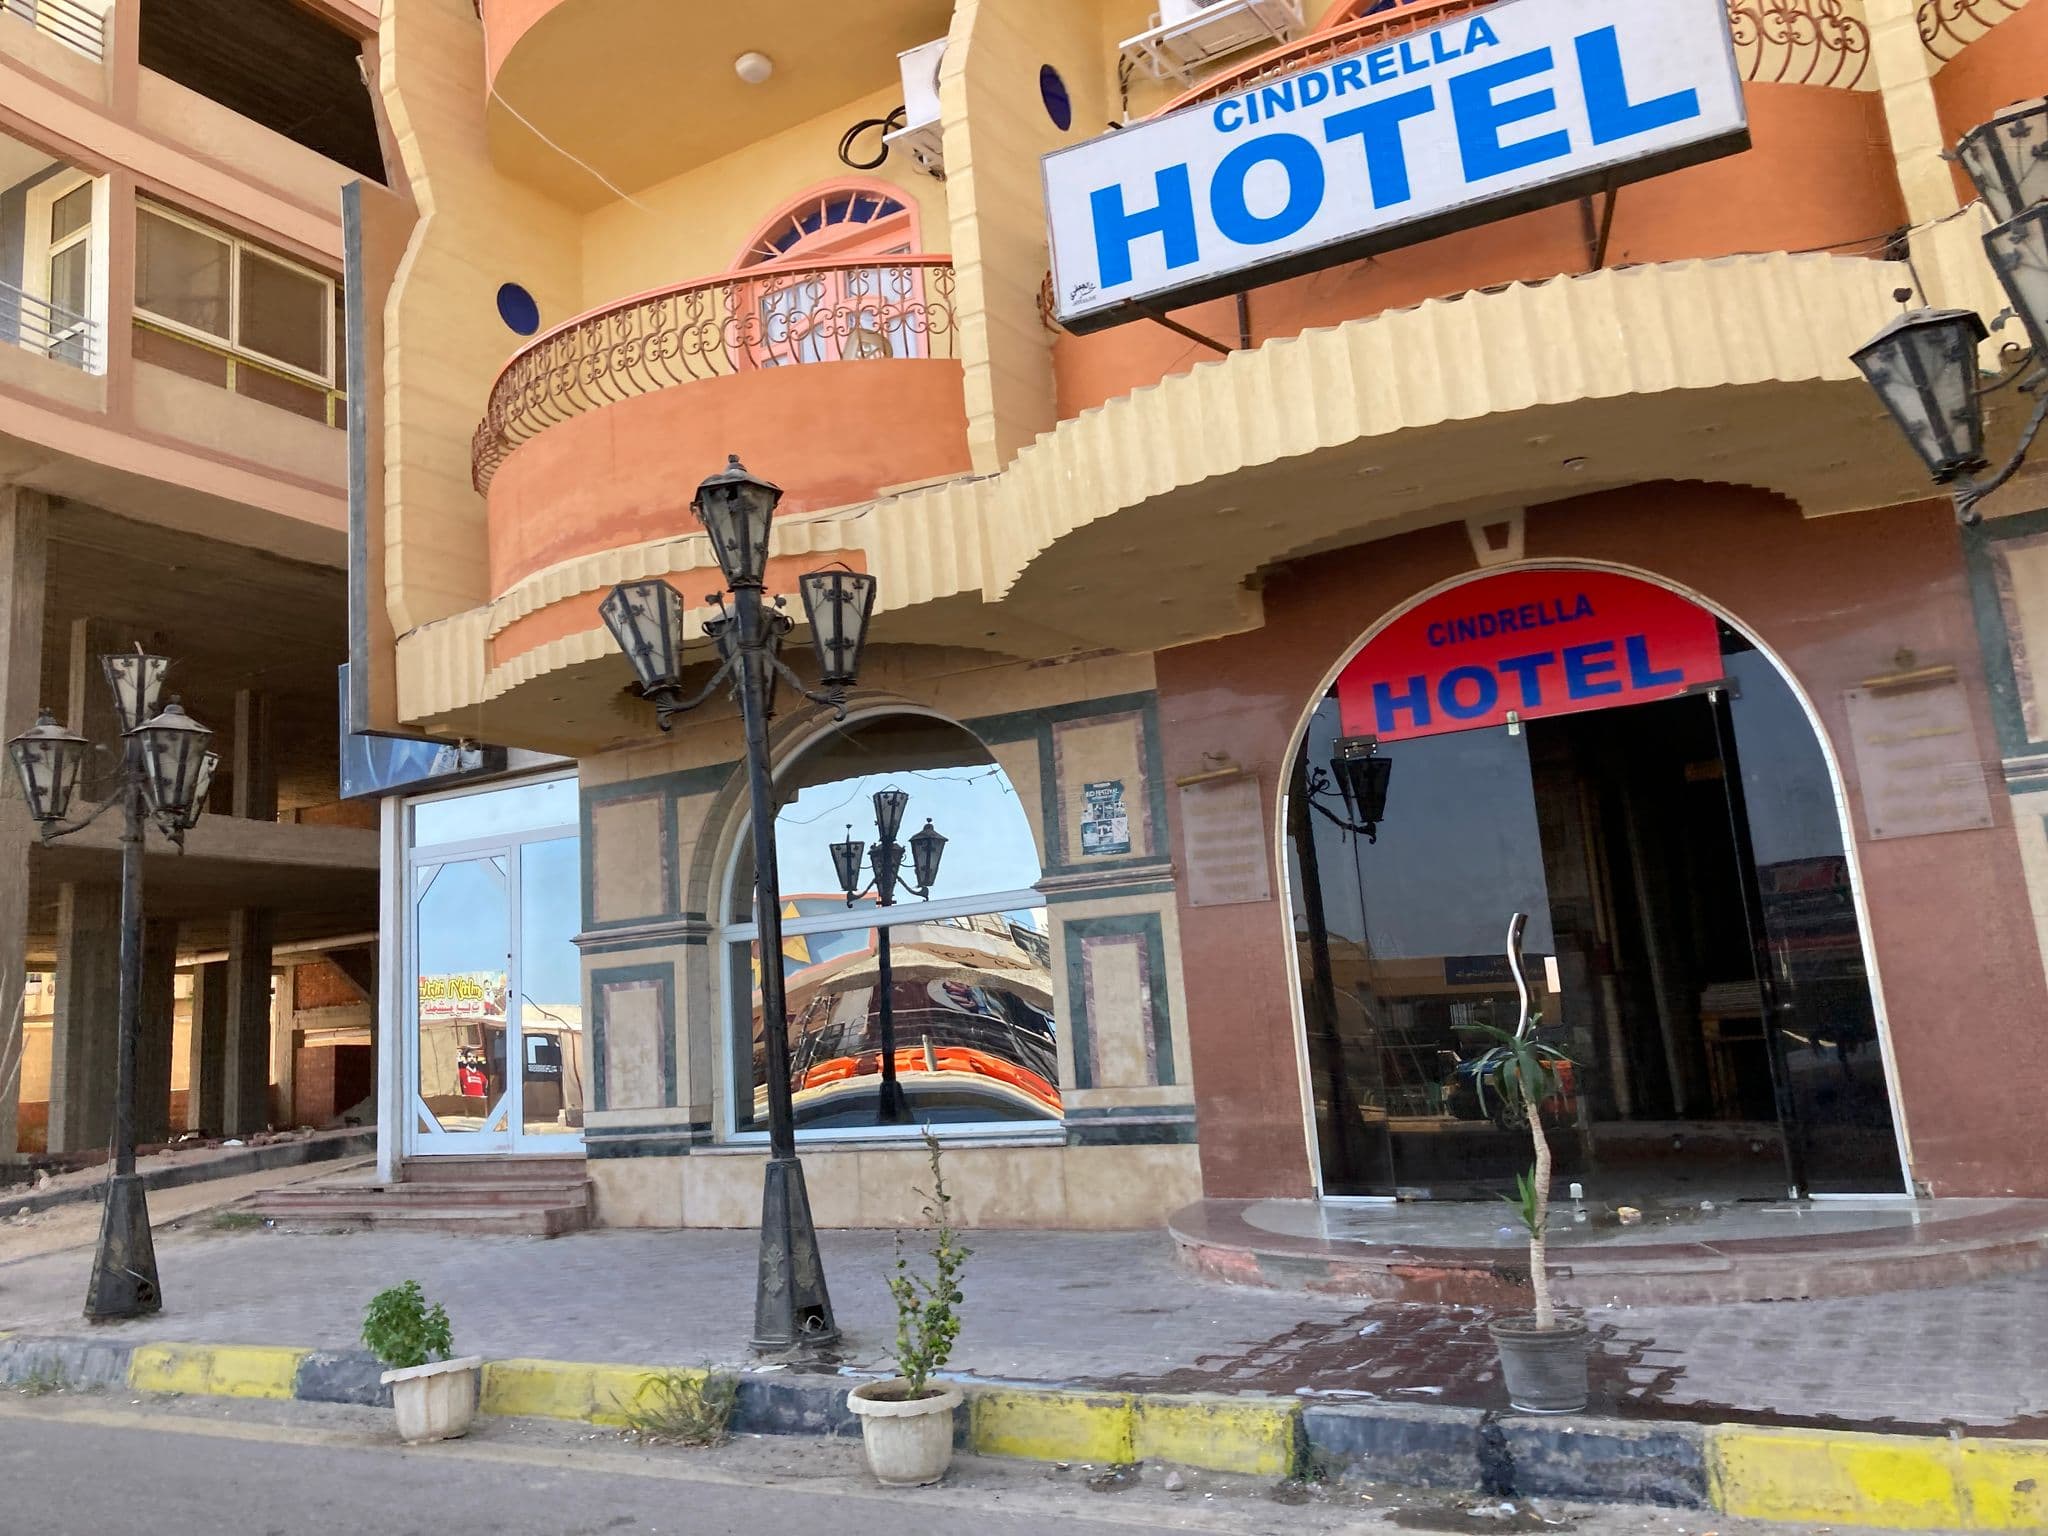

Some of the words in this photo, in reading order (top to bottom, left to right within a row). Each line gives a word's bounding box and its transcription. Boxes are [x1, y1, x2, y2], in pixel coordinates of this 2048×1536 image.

[1214, 16, 1499, 133] CINDRELLA
[1089, 25, 1700, 289] HOTEL
[1427, 593, 1595, 648] CINDRELLA
[1372, 633, 1685, 734] HOTEL
